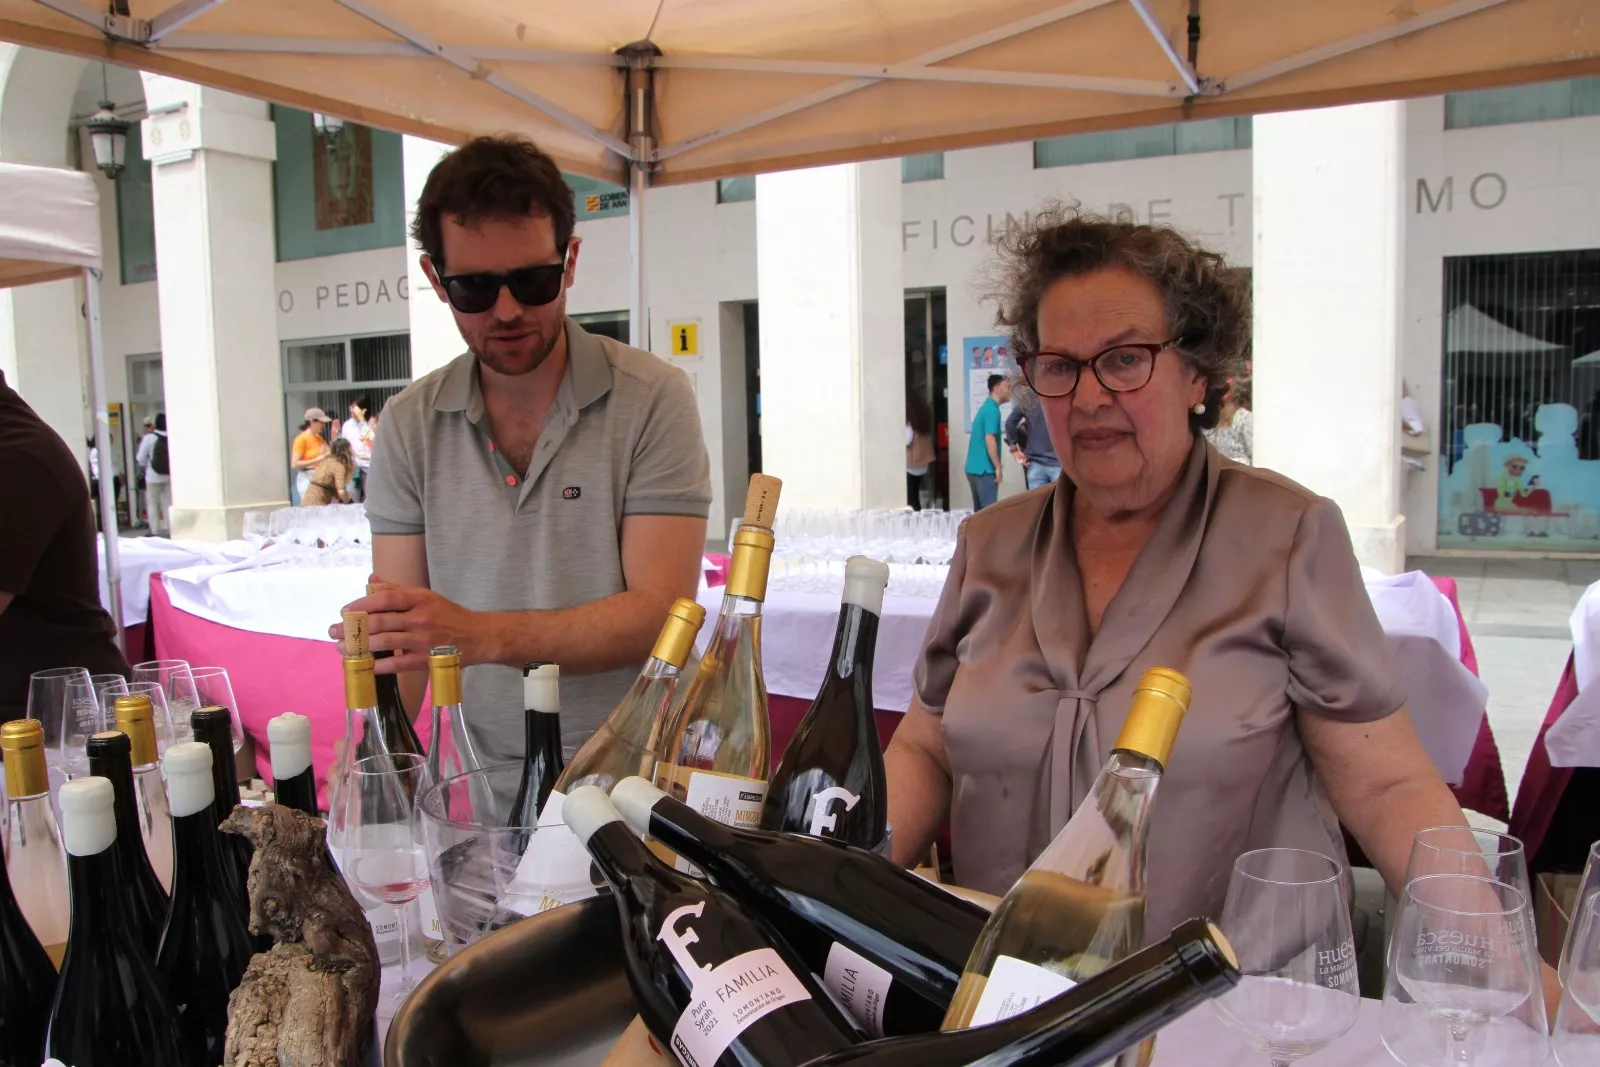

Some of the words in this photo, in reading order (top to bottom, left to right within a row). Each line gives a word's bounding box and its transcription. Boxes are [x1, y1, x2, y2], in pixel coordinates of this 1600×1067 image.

[1416, 173, 1507, 213] MO
[901, 208, 1036, 252] FICIN
[1218, 193, 1245, 236] T
[316, 275, 409, 310] PEDAG
[716, 964, 779, 1004] FAMILIA
[691, 1000, 707, 1018] Puro
[732, 987, 782, 1019] SOMONTANO
[694, 1009, 713, 1031] Syrah
[703, 1018, 719, 1036] 2021
